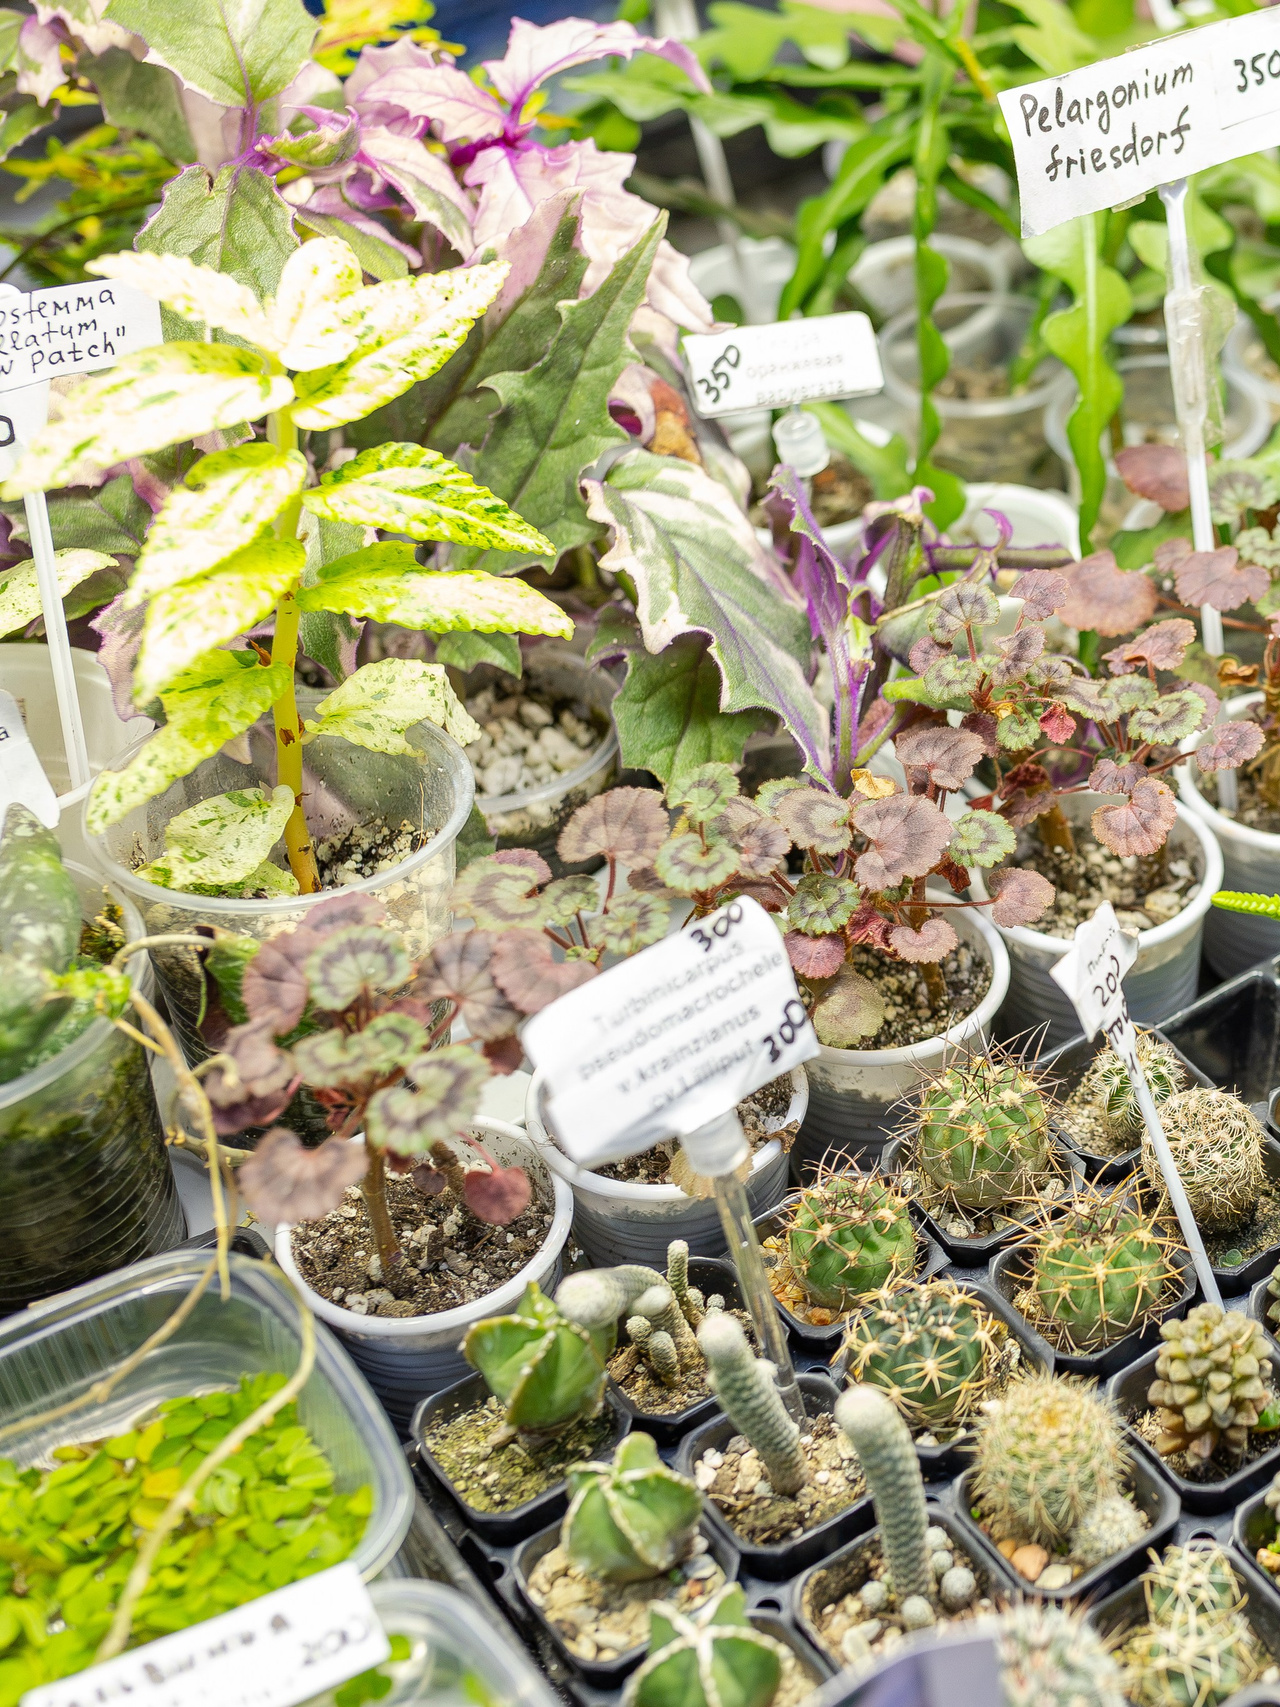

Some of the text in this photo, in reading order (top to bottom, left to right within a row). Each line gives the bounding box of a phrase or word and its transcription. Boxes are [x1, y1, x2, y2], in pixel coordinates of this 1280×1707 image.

[1019, 62, 1194, 137] Pelargonium
[1045, 105, 1191, 182] friesdorf
[697, 344, 741, 404] 350
[690, 902, 743, 952] 300
[762, 999, 809, 1064] 300
